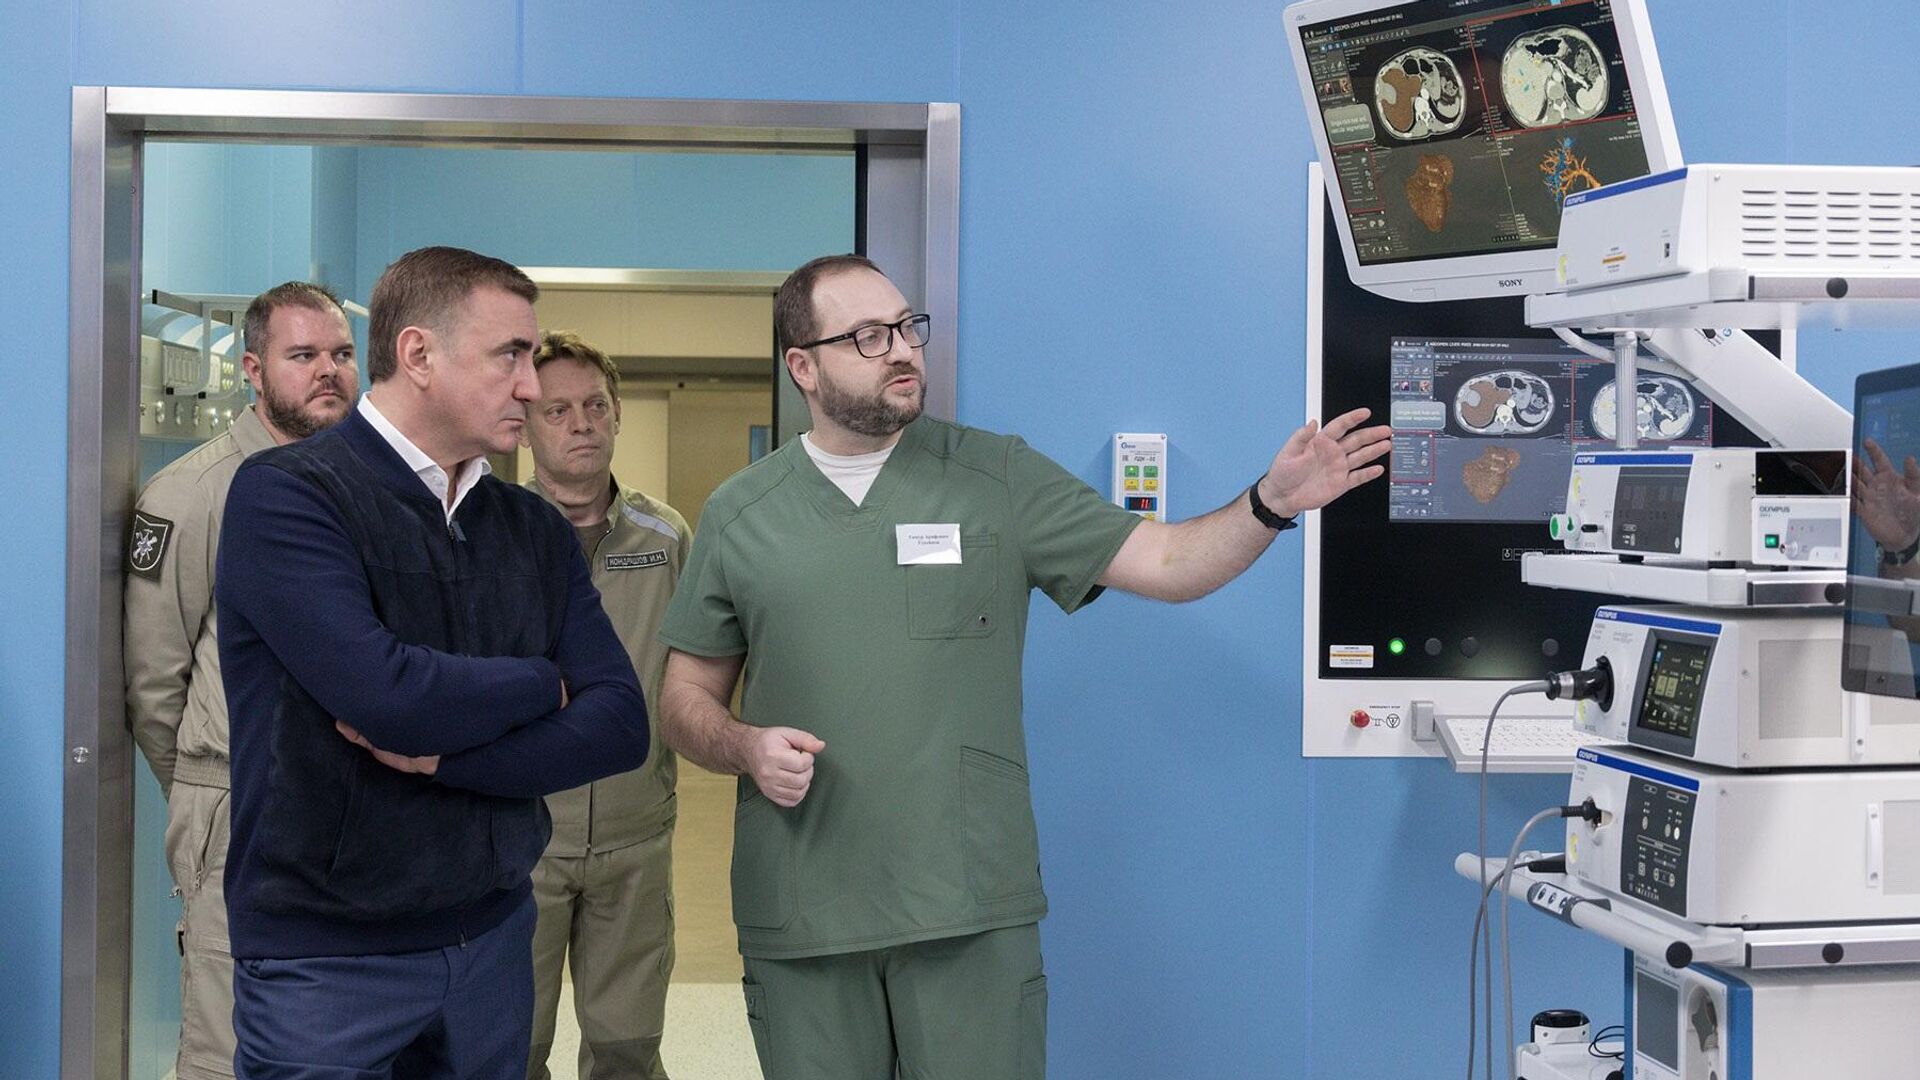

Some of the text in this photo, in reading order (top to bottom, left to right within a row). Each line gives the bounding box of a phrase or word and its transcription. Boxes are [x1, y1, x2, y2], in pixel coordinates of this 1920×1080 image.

[1498, 279, 1523, 288] SONY
[1576, 456, 1596, 464] OLYMPUS
[1597, 610, 1618, 620] OLYMPUS
[1578, 750, 1599, 762] OLYMPUS
